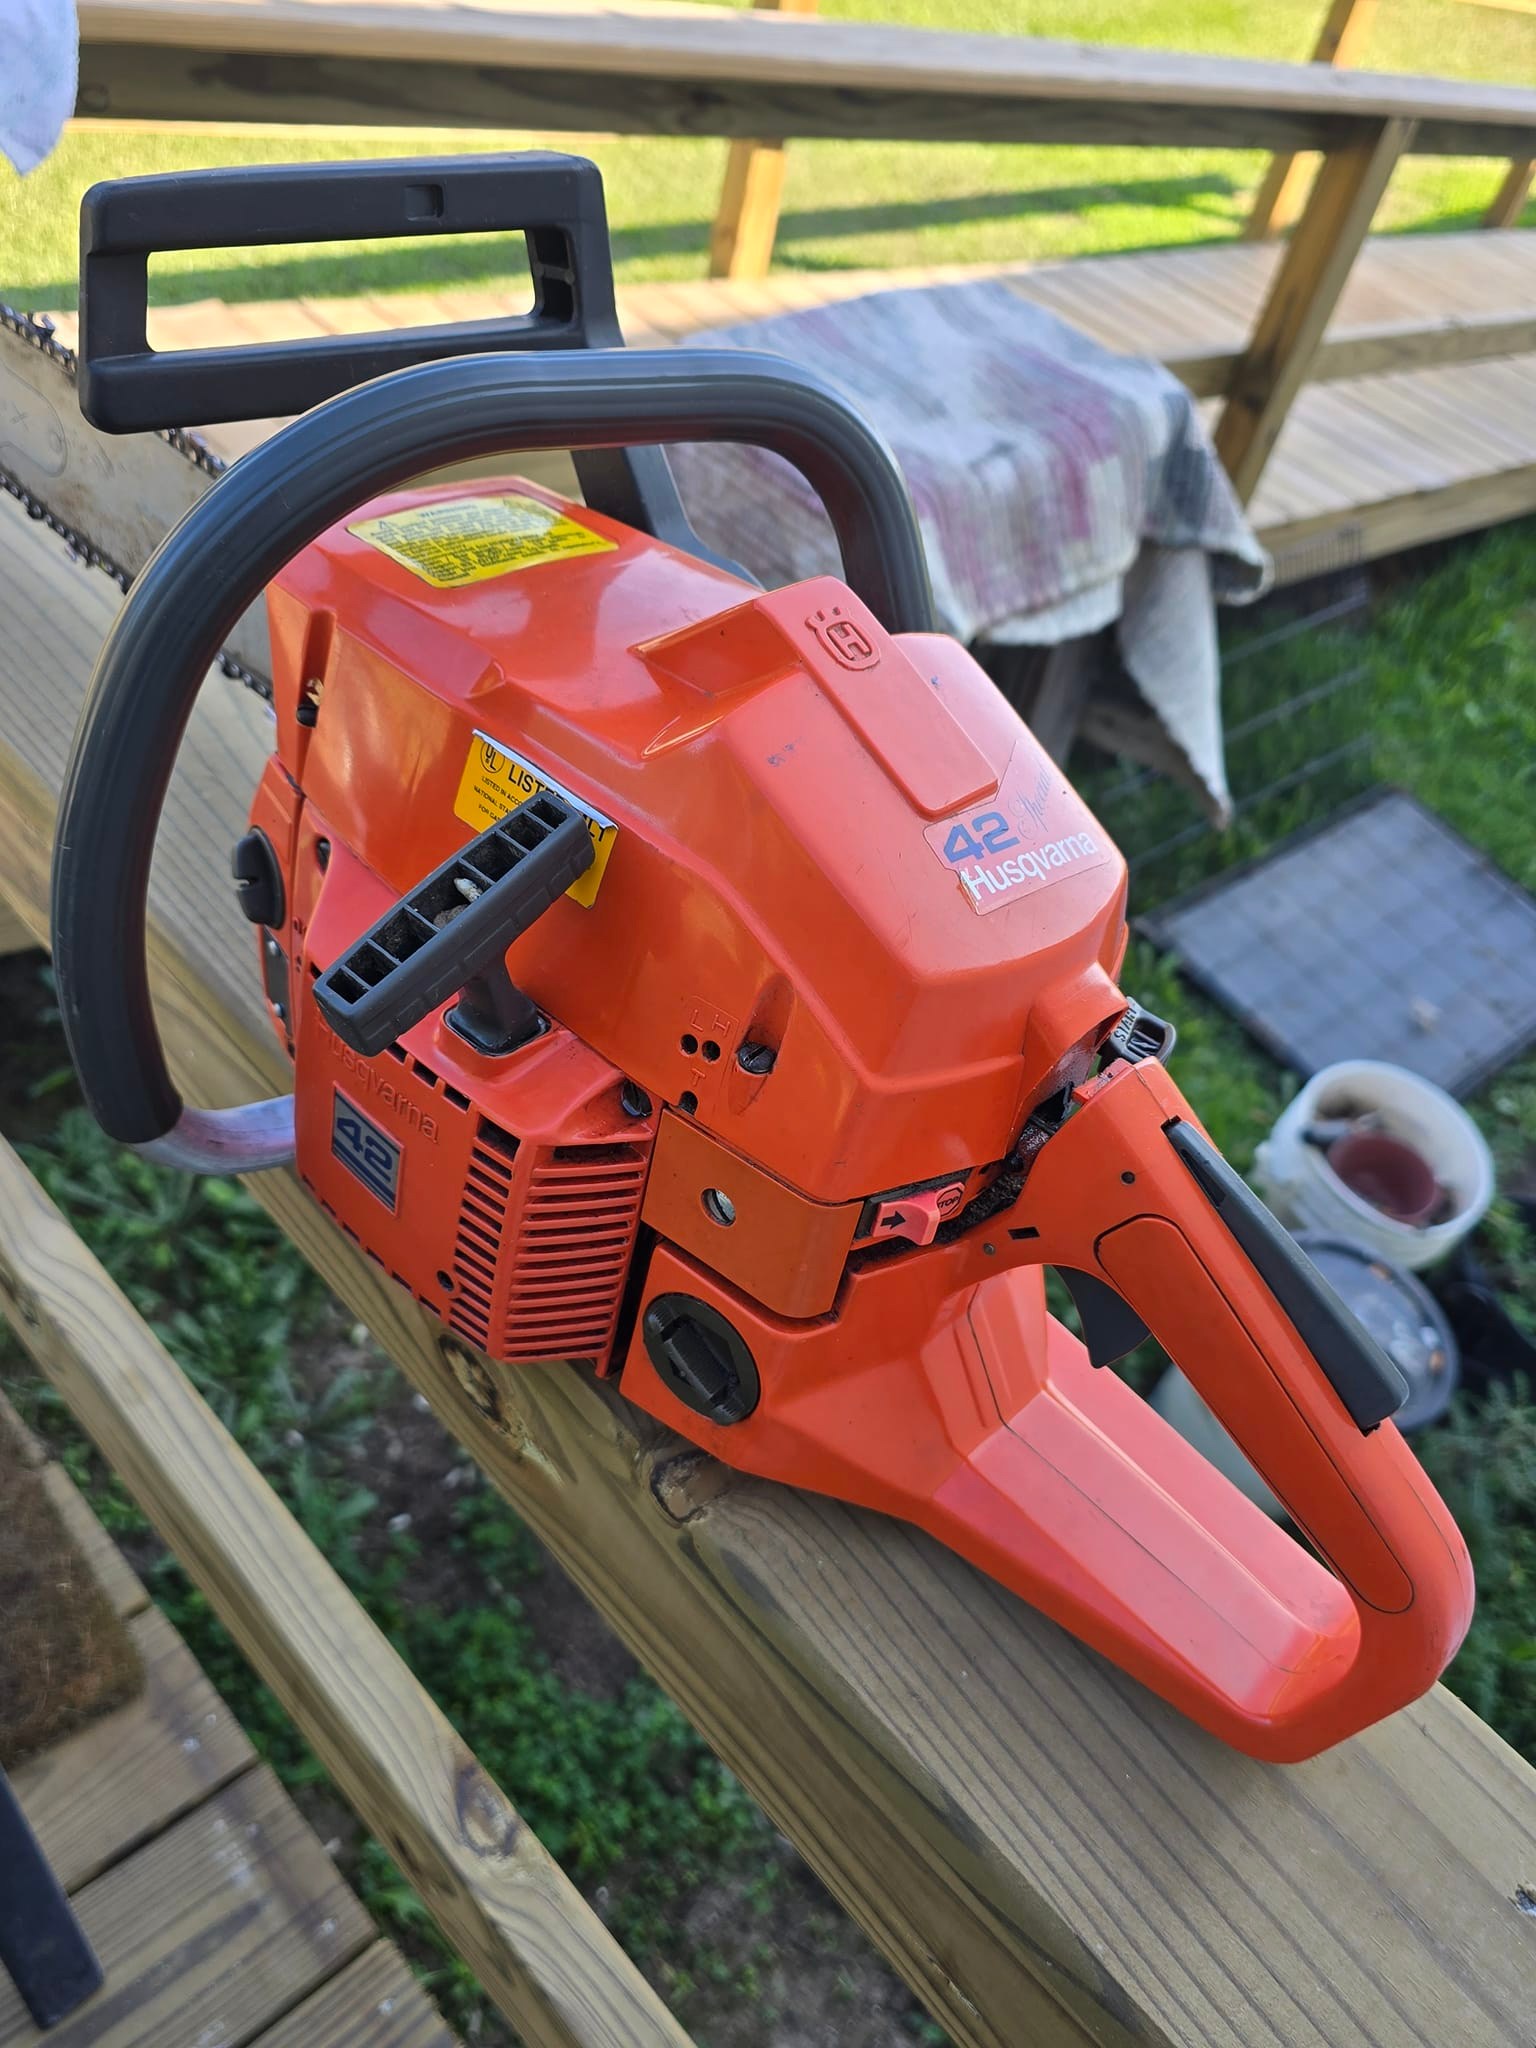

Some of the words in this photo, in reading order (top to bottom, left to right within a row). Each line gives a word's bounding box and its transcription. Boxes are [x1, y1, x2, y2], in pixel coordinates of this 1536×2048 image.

[943, 811, 1020, 863] 42
[960, 832, 1097, 900] Husqvarna
[336, 1116, 393, 1183] 42
